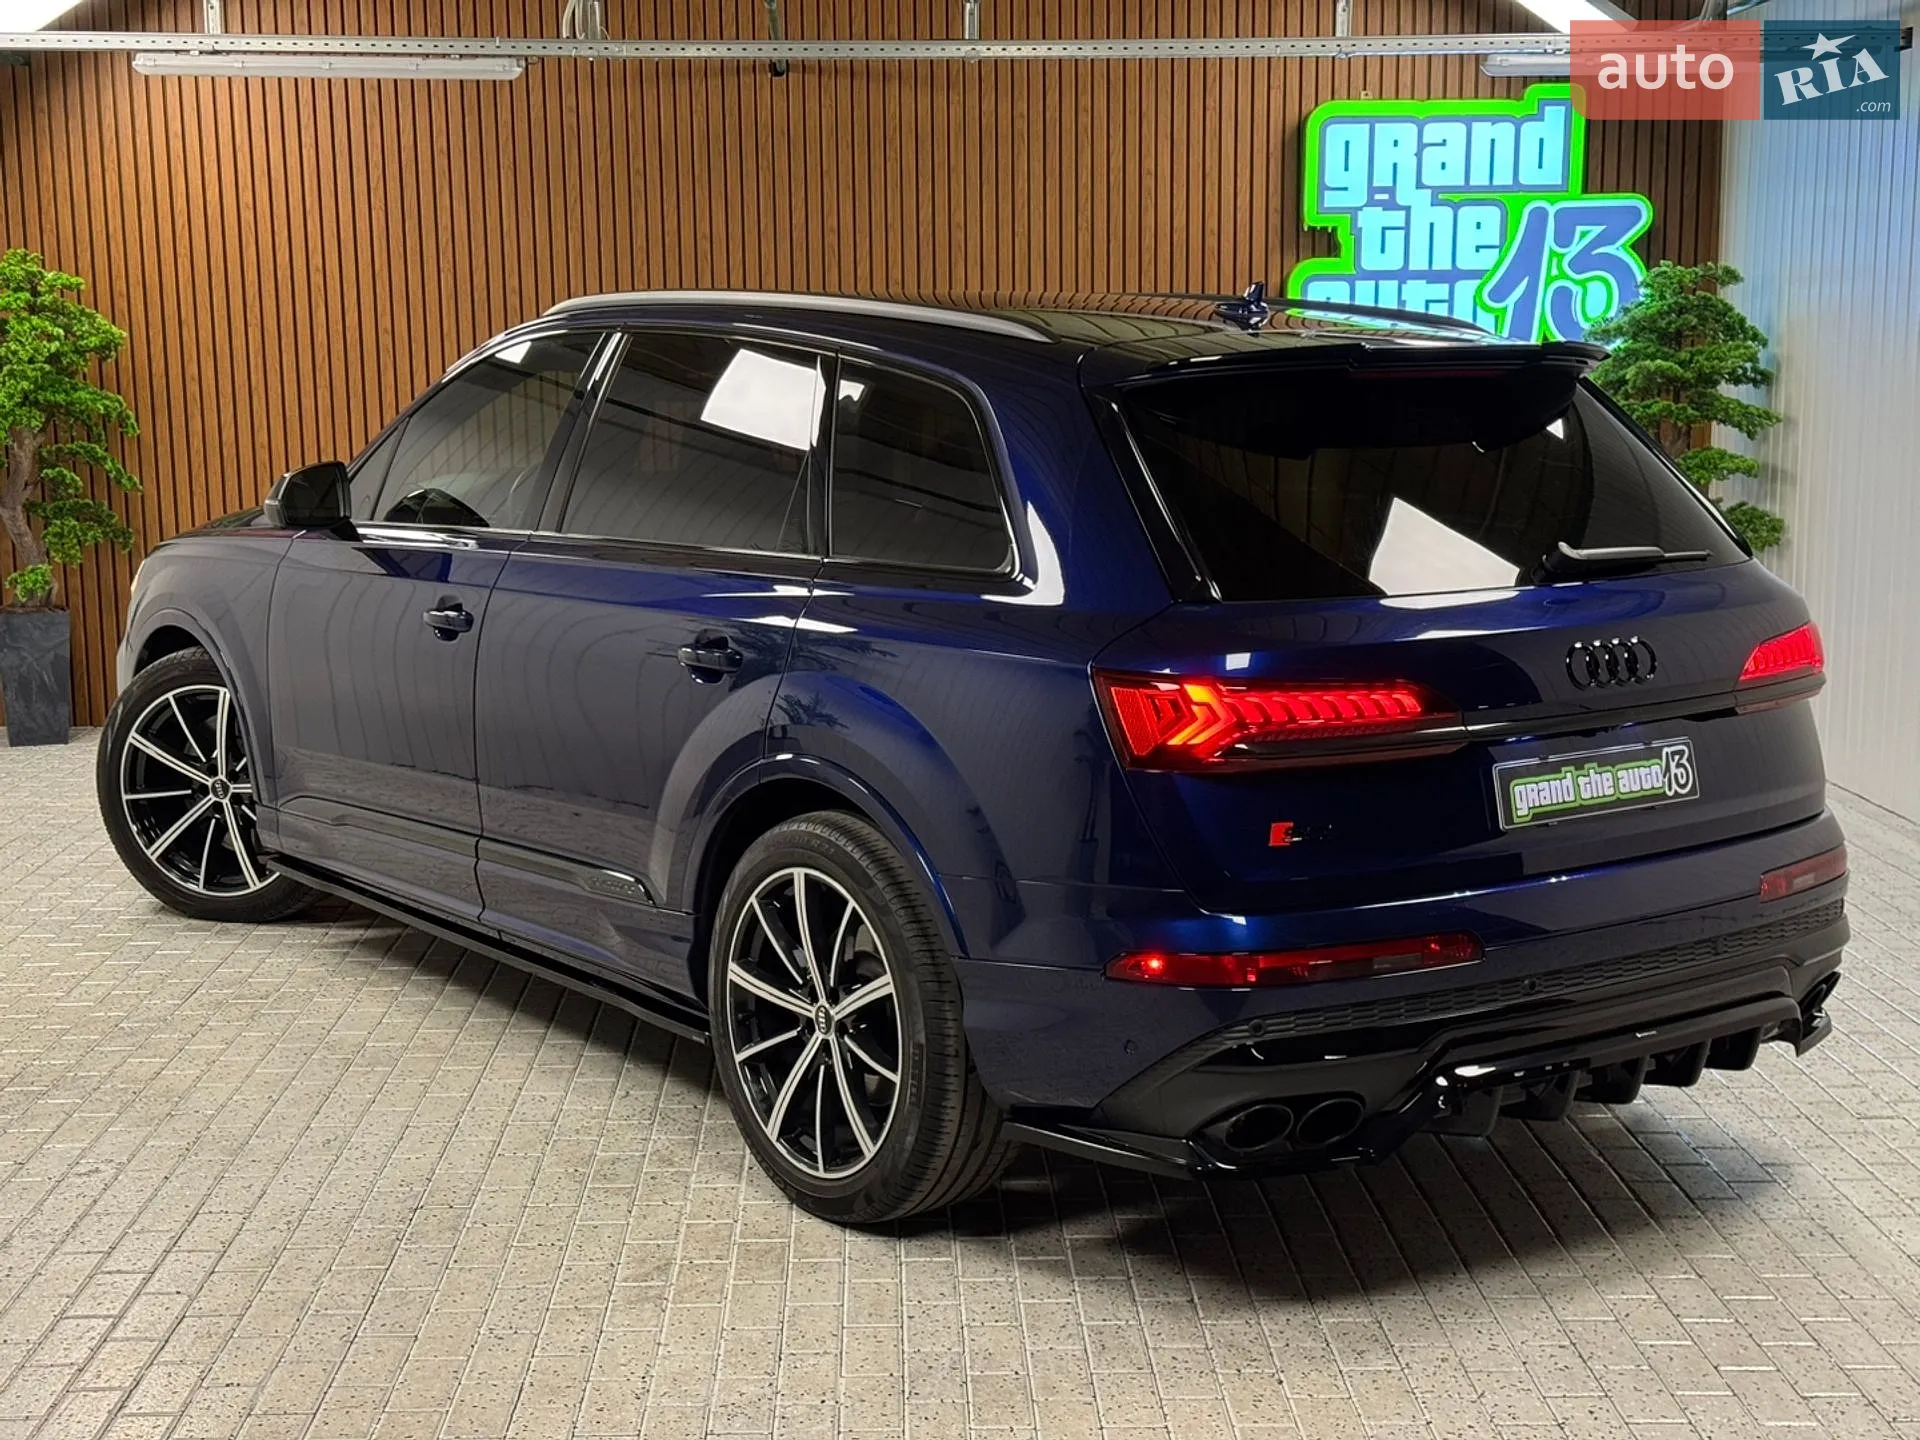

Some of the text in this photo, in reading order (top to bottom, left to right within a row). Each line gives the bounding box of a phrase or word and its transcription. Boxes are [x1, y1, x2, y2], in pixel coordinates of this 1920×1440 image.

[1358, 190, 1500, 271] the
[1484, 200, 1650, 344] 13
[1578, 769, 1615, 800] the
[1617, 765, 1664, 794] auto
[1661, 745, 1694, 797] 13
